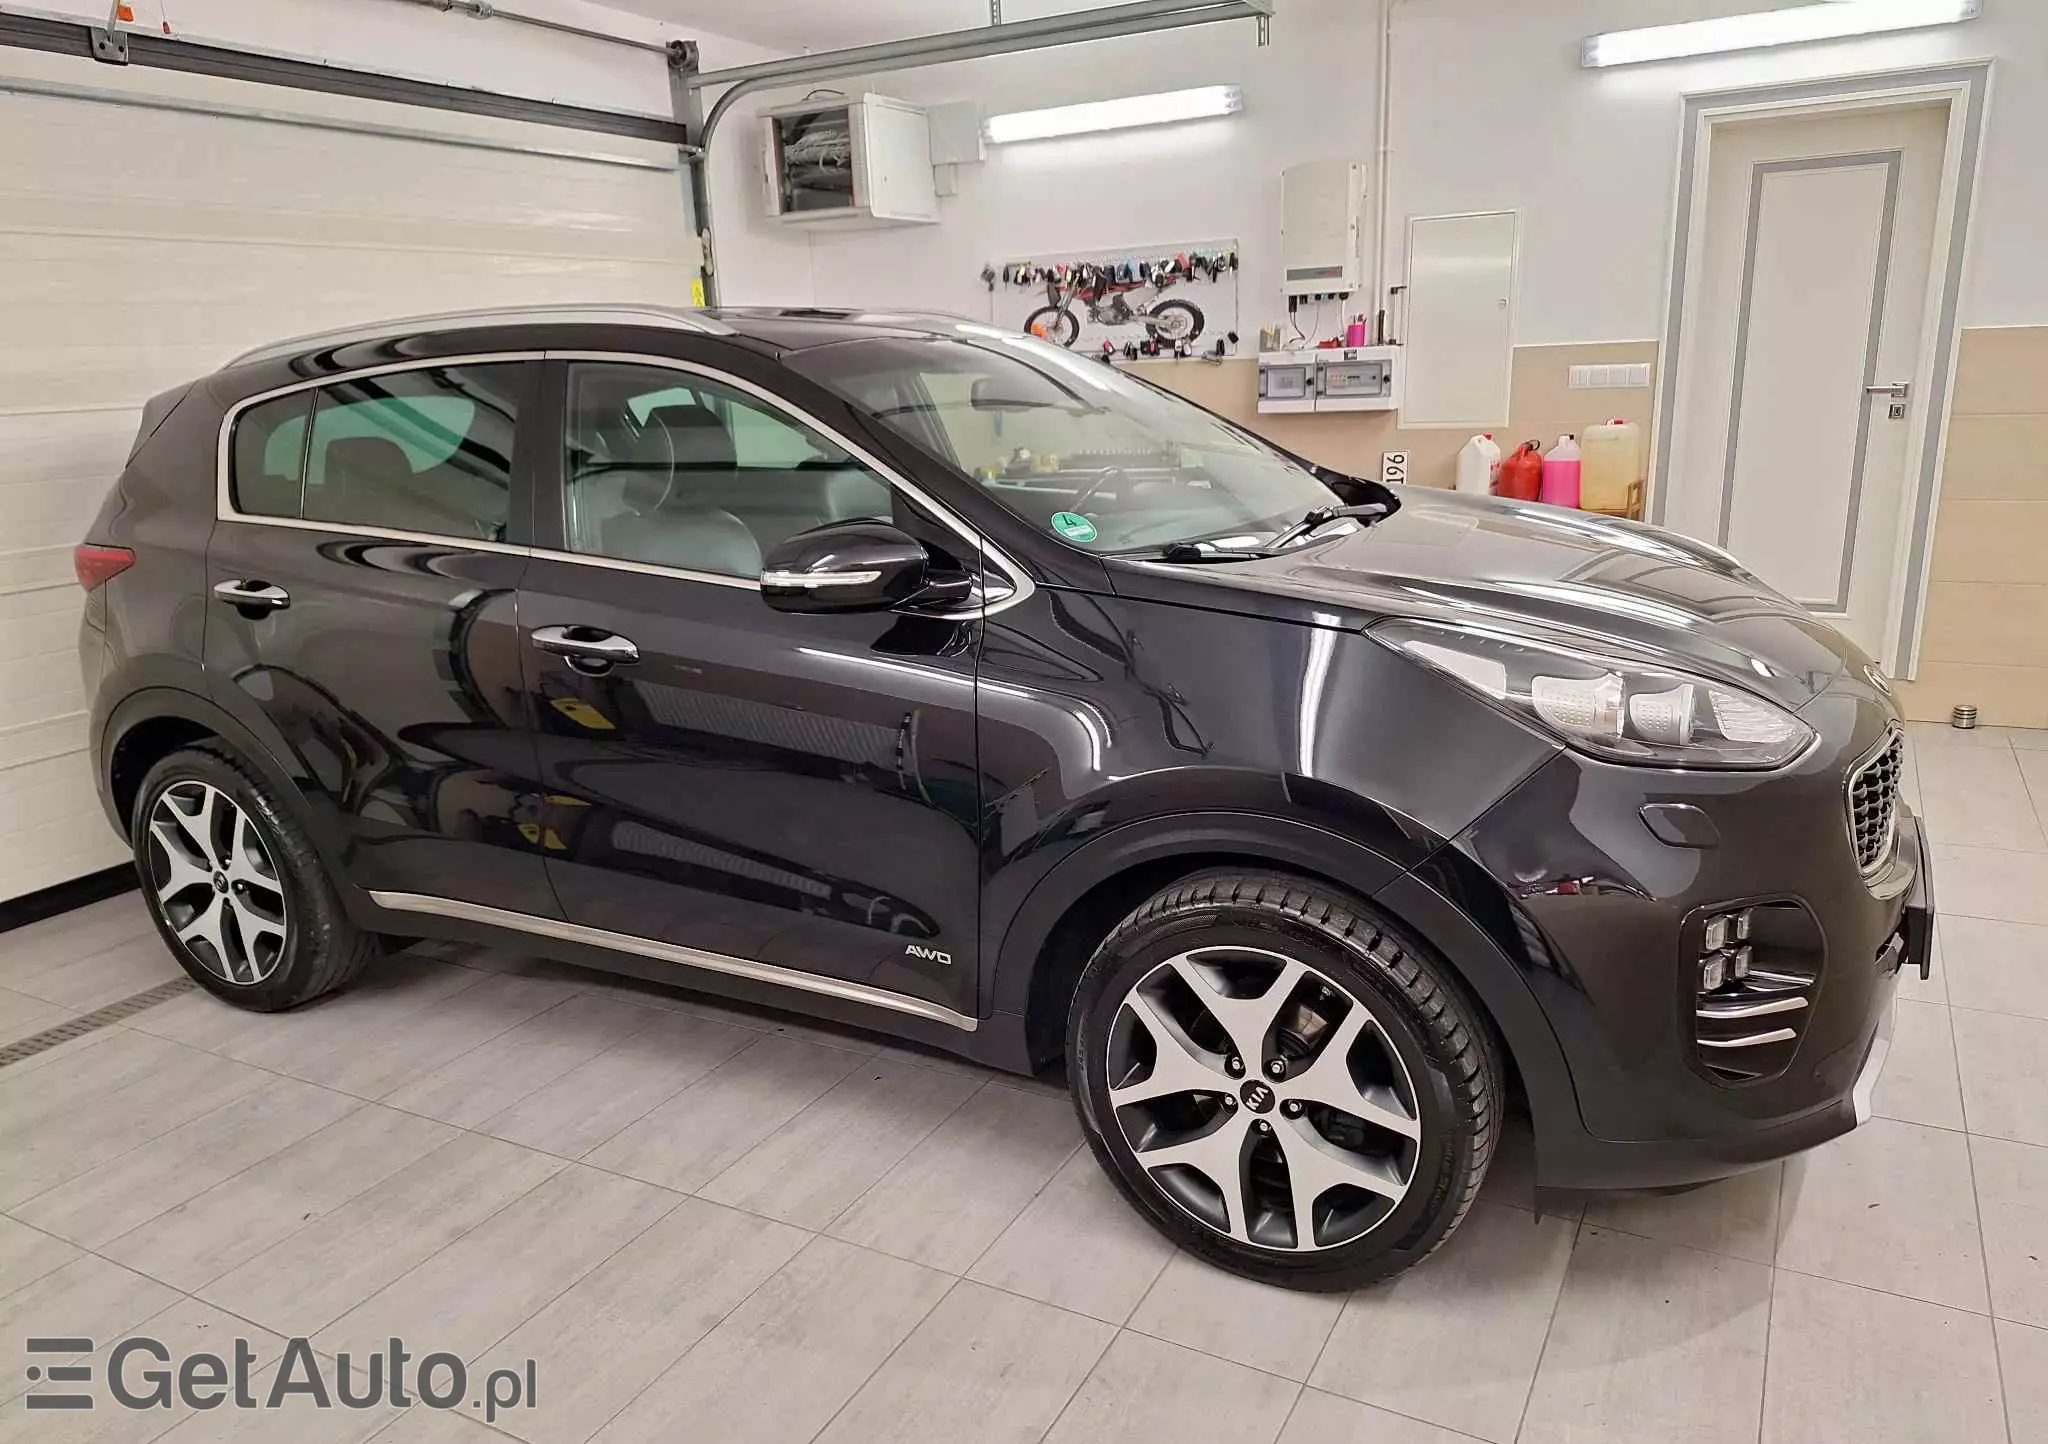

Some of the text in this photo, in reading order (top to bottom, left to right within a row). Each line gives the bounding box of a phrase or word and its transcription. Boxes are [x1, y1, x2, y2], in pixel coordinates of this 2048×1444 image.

[1386, 454, 1405, 485] 196
[1062, 514, 1077, 527] 4
[904, 944, 952, 966] AWD
[1245, 1086, 1270, 1112] KIA
